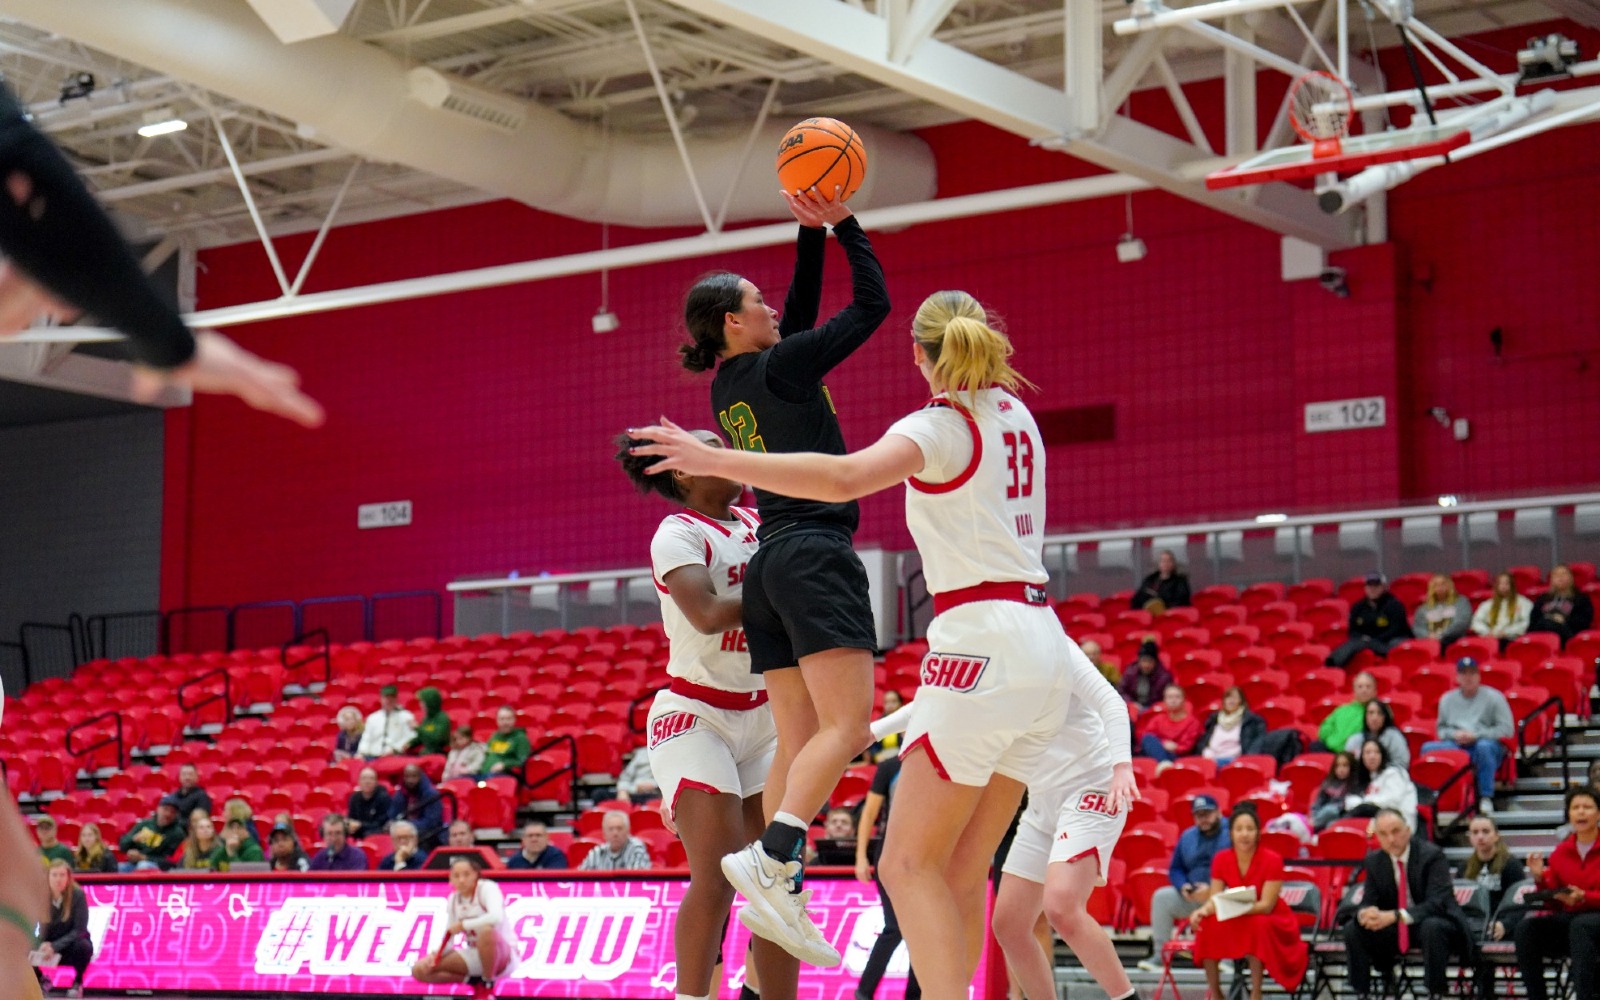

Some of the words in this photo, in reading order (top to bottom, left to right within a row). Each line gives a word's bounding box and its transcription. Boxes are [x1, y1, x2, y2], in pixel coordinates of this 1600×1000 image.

[719, 401, 767, 453] 12
[1341, 401, 1380, 423] 102
[1002, 430, 1034, 499] 33
[923, 656, 985, 690] SHU
[651, 713, 698, 747] SHU
